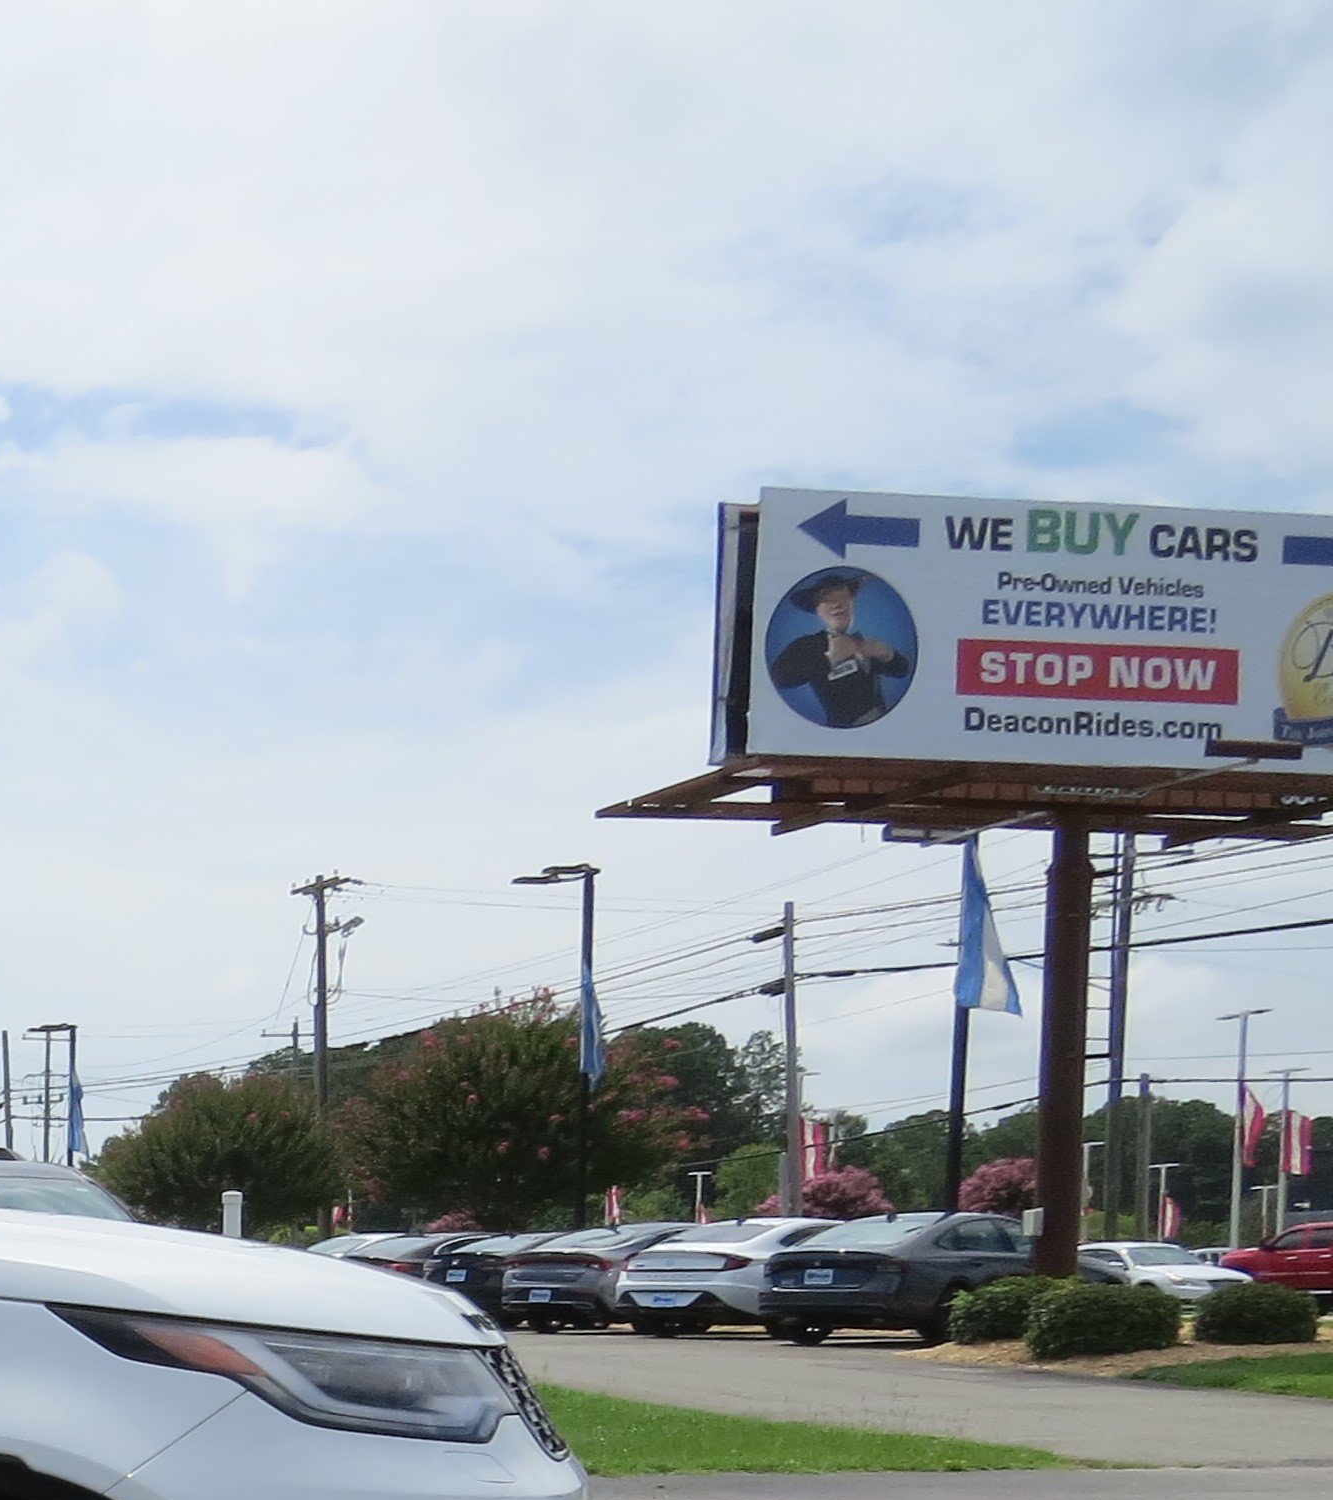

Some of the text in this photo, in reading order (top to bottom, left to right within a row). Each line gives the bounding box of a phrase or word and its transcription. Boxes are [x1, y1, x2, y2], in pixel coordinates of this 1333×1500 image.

[944, 508, 1259, 563] WE BUY CARS
[996, 571, 1205, 599] Pre-Owned Vehicles
[982, 599, 1217, 634] EVERYWHERE!
[979, 651, 1217, 692] STOP NOW
[963, 706, 1223, 741] DeaconRides.com
